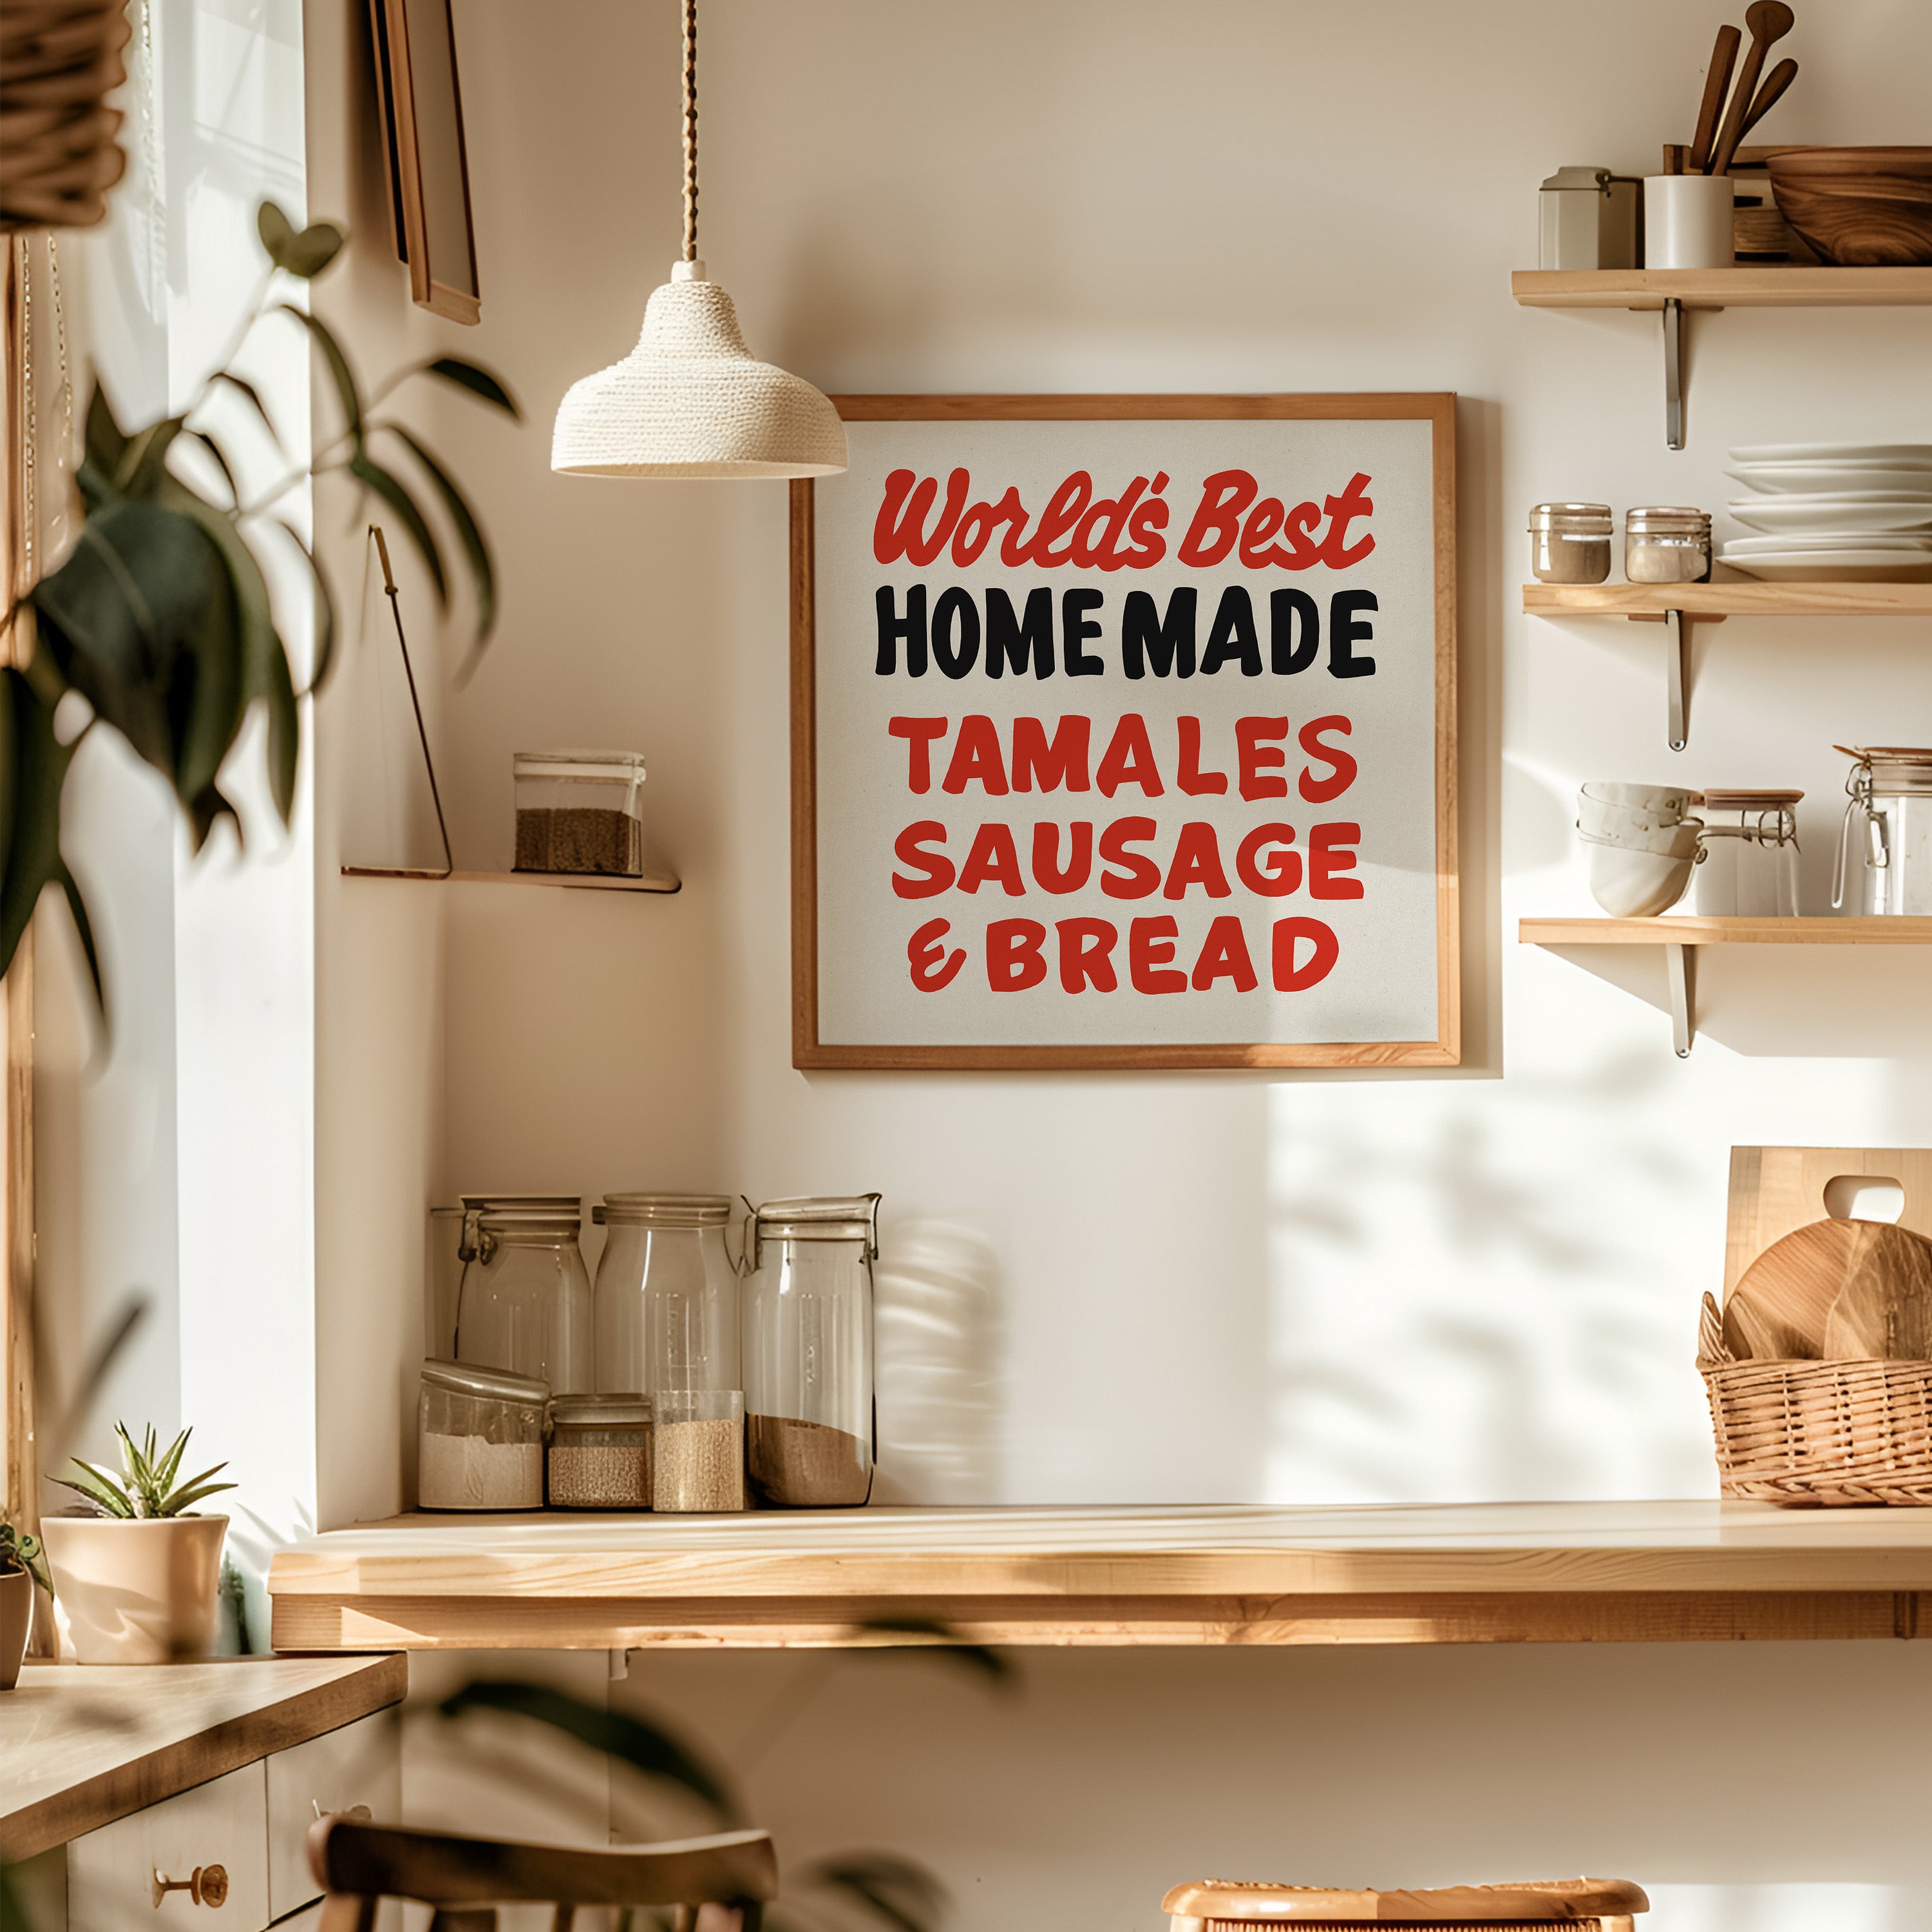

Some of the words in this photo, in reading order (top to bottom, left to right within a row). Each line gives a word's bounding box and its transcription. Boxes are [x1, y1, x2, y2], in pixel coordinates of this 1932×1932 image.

[873, 468, 1170, 572] World's
[1177, 469, 1376, 571] Best
[875, 583, 1104, 681] HOME
[1122, 585, 1379, 680] MADE
[888, 713, 1358, 804] TAMALES
[892, 816, 1365, 901] SAUSAGE
[907, 918, 967, 993] &
[986, 915, 1340, 995] BREAD
